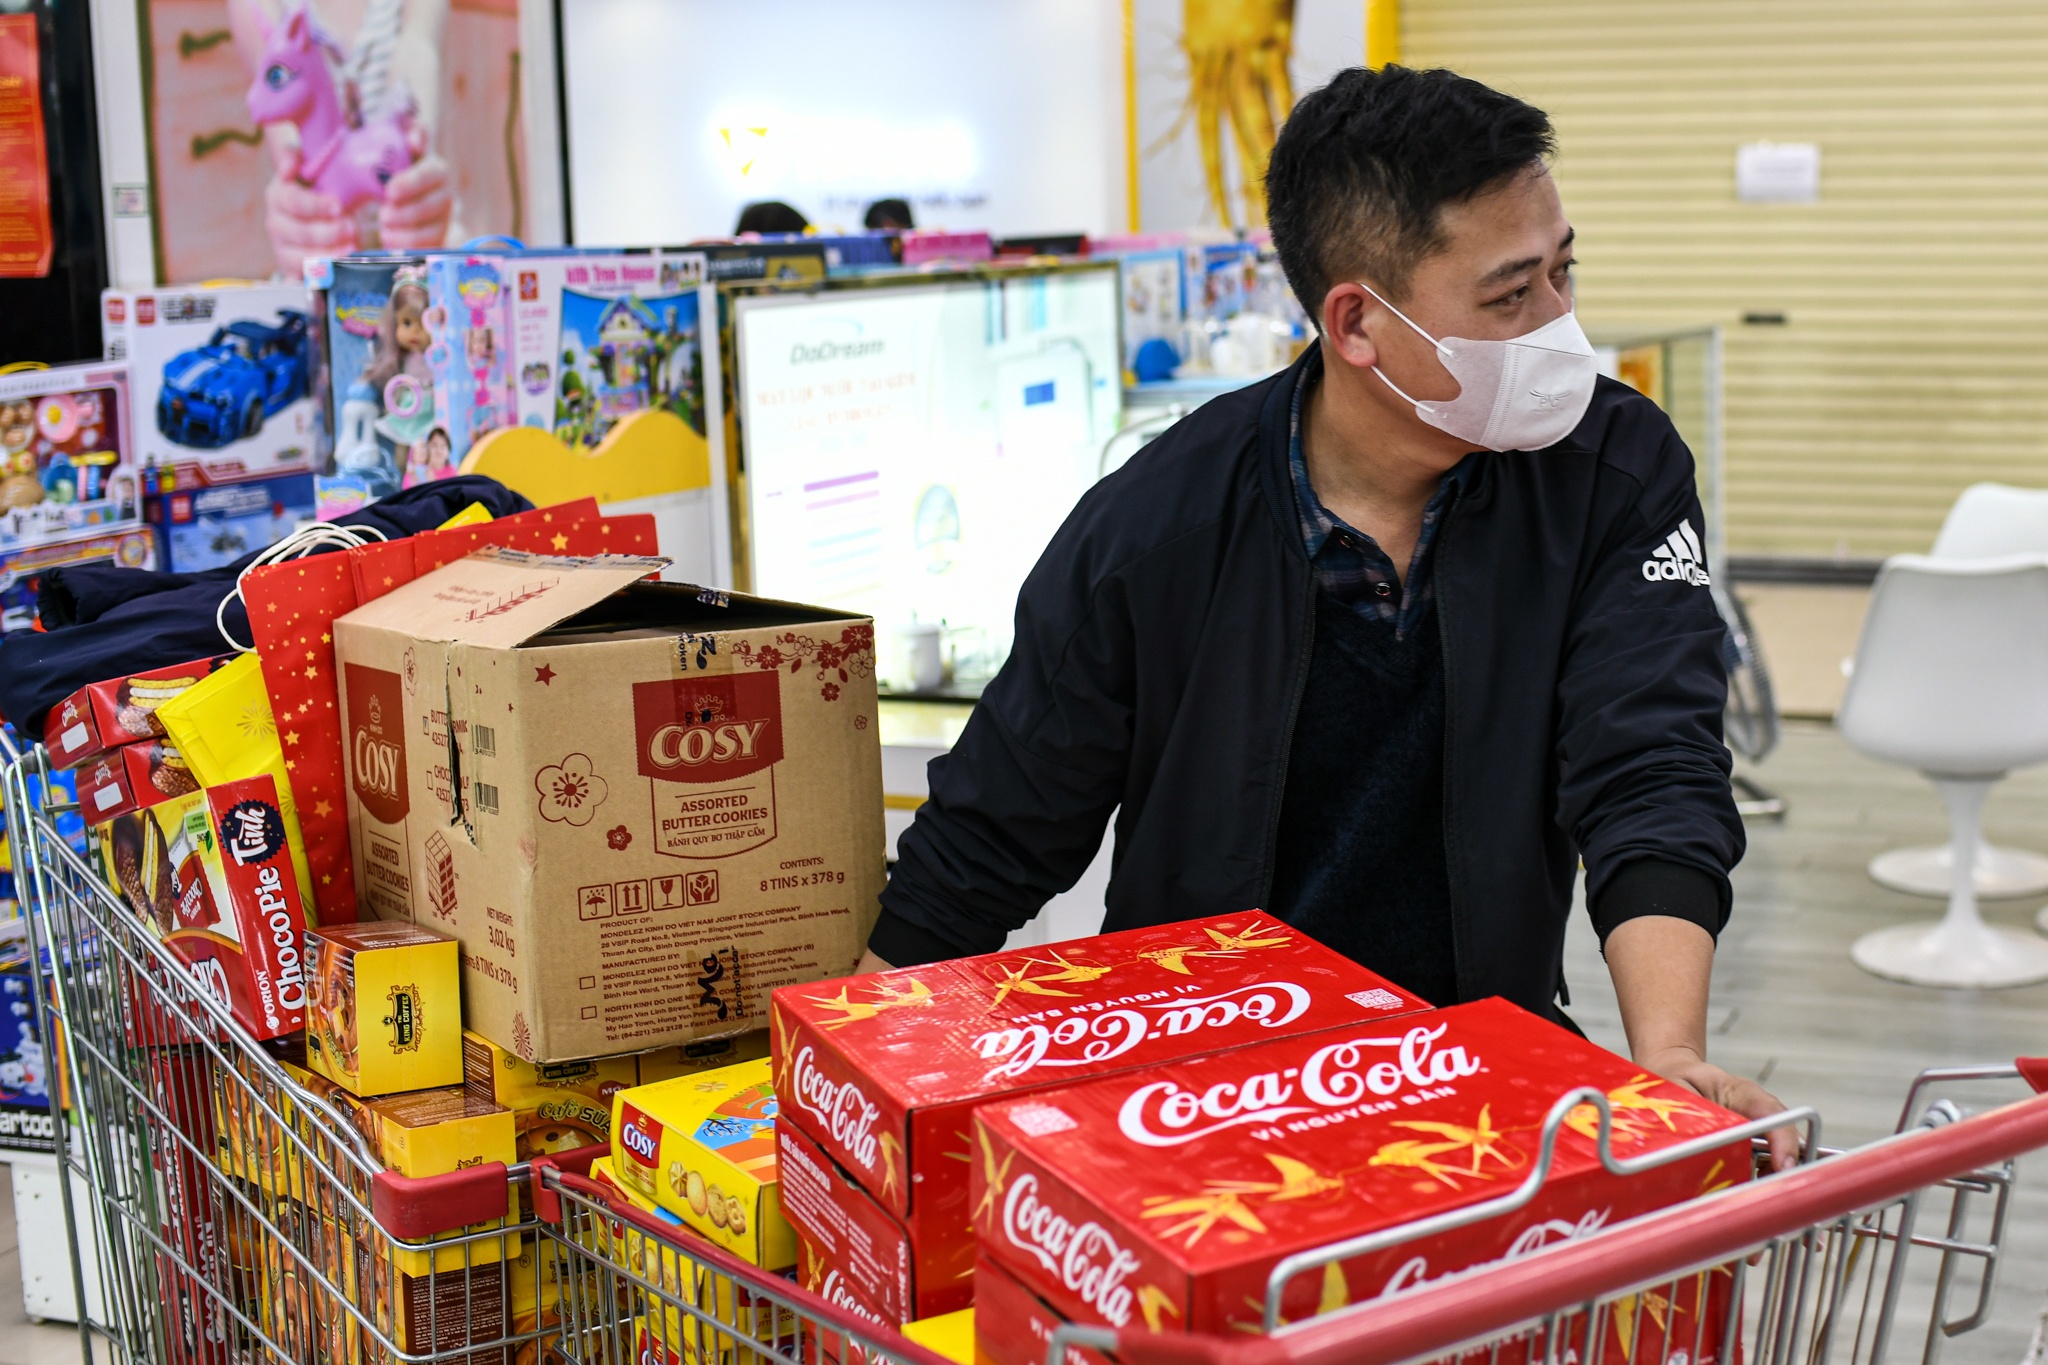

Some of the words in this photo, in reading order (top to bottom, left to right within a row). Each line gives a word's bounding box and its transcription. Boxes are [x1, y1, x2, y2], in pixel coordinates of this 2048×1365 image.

[1642, 556, 1710, 587] adids
[679, 637, 687, 671] roken
[649, 719, 768, 769] COSY
[356, 729, 399, 799] COSY
[681, 795, 748, 813] ASSORTED
[662, 814, 711, 831] BUTTER
[713, 808, 768, 824] COOKIES
[371, 842, 399, 866] ASSORTED
[780, 857, 824, 869] CONTENTS:
[760, 881, 768, 891] 8
[770, 876, 798, 890] TINS
[801, 877, 808, 886] x
[811, 871, 834, 884] 378
[837, 872, 845, 883] g
[600, 928, 643, 939] MONDELEZ
[678, 921, 697, 929] VIET
[697, 918, 714, 926] NAM
[715, 915, 738, 923] JOINT
[738, 911, 764, 920] STOCK
[765, 906, 802, 916] COMPANY
[600, 919, 638, 929] PRODUCT
[639, 917, 653, 925] OF:
[611, 939, 629, 947] VSIP
[671, 929, 701, 939] Vietnam
[708, 924, 744, 933] Singapore
[745, 918, 778, 928] Industrial
[255, 866, 306, 1011] ChocoPie
[489, 925, 505, 949] 3,02
[505, 930, 515, 957] kg
[601, 950, 625, 958] Thuan
[638, 945, 655, 954] City,
[674, 939, 699, 948] Duong
[700, 934, 733, 943] Province,
[500, 967, 512, 987] 378
[602, 954, 667, 970] MANUFACTURED
[602, 970, 646, 981] MONDELEZ
[680, 961, 698, 969] VIET
[740, 952, 766, 961] STOCK
[767, 946, 802, 956] COMPANY
[661, 983, 685, 991] Thuan
[790, 962, 818, 970] Vietnam
[258, 971, 275, 1015] ORION
[604, 1005, 632, 1013] NORTH
[757, 980, 786, 989] LIMITED
[402, 995, 410, 1023] COFFEE
[605, 1014, 634, 1023] Nguyen
[402, 1024, 411, 1043] KING
[606, 1025, 617, 1034] My
[658, 1016, 678, 1026] Hung
[971, 981, 1312, 1082] Coca-Cola
[1118, 1021, 1482, 1148] Coca-Cola
[793, 1045, 881, 1170] Coca-Cola
[622, 1121, 656, 1161] COSY
[1003, 1173, 1141, 1328] Coca-Cola
